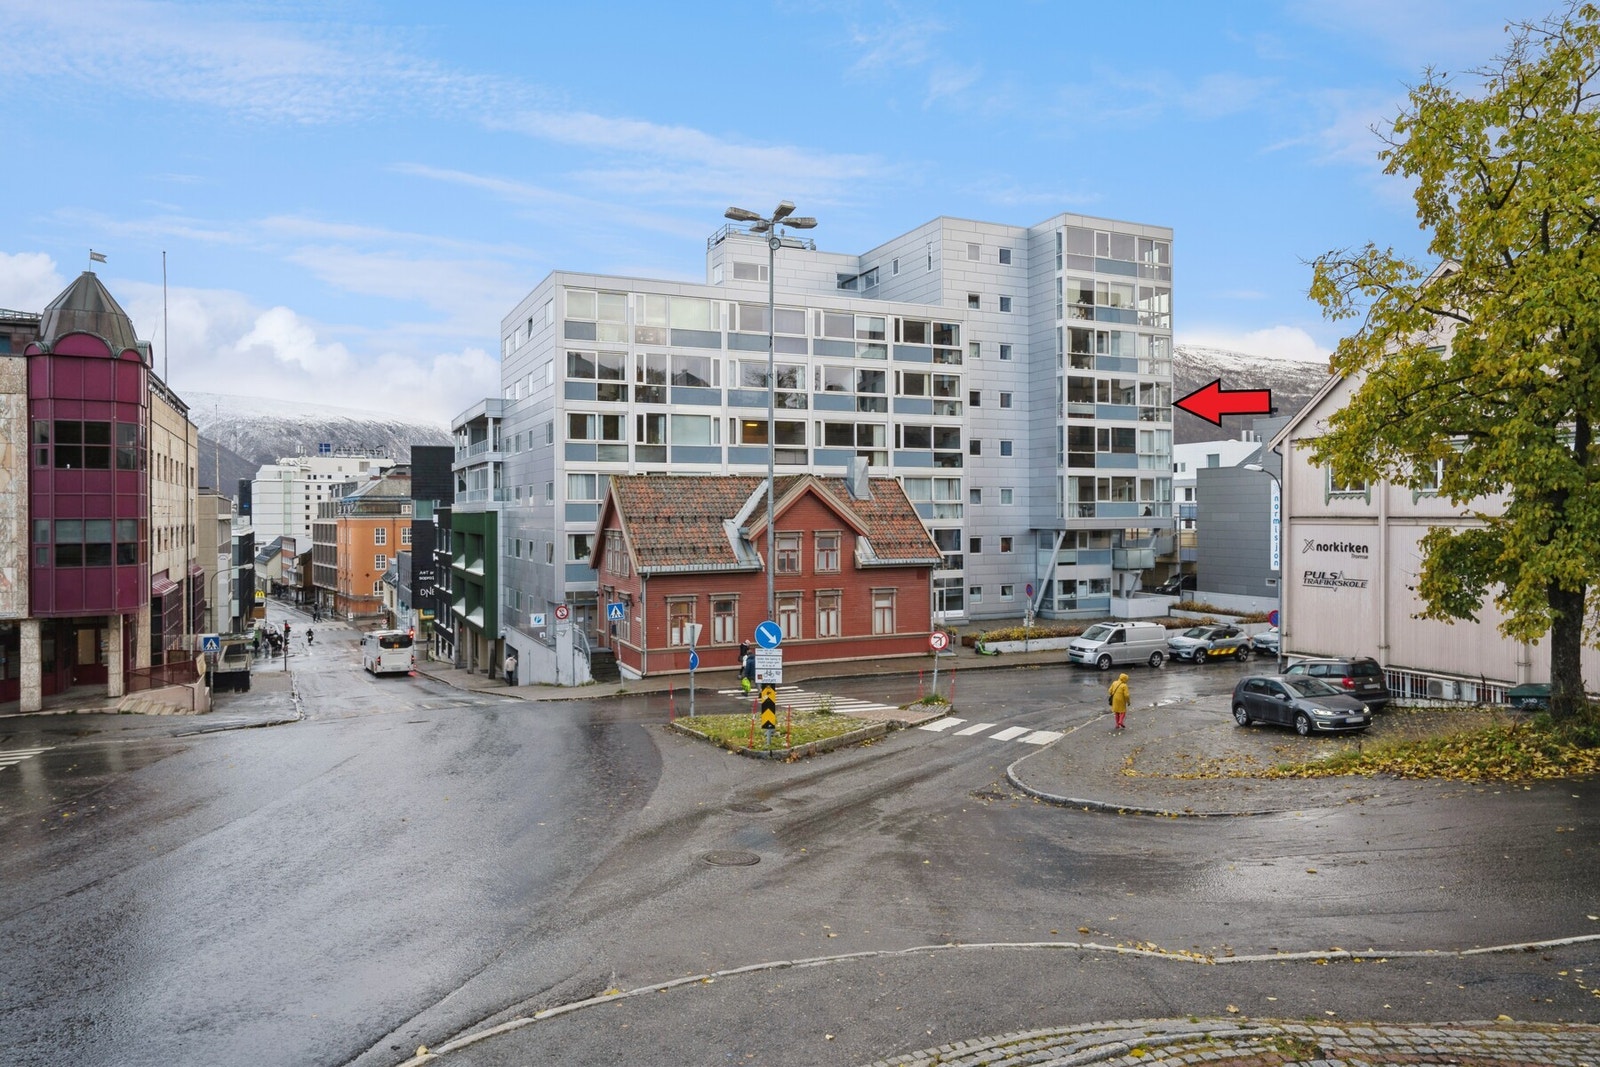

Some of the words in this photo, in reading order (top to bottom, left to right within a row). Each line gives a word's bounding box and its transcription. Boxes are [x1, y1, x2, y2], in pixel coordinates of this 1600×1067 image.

[1316, 541, 1369, 553] norkirken
[1303, 570, 1339, 580] PULS
[1303, 578, 1368, 589] TRAFIKKSKOLE
